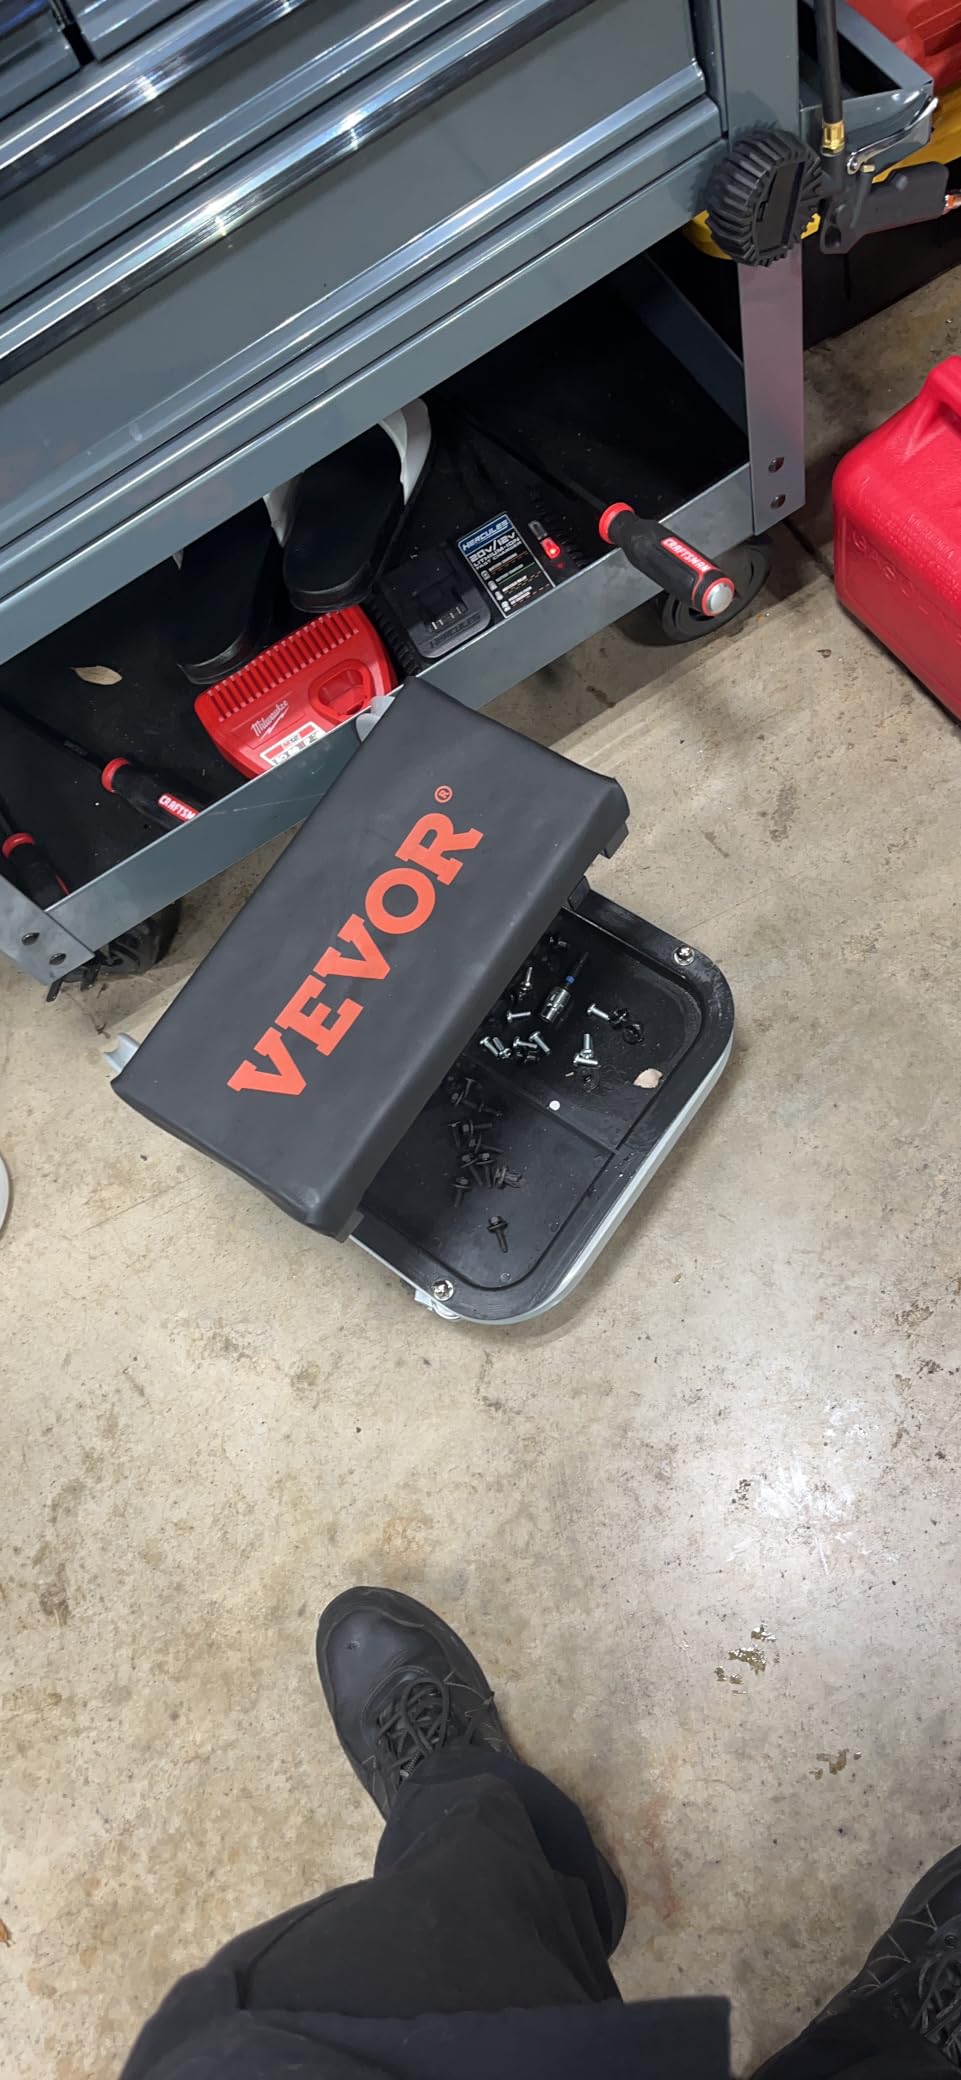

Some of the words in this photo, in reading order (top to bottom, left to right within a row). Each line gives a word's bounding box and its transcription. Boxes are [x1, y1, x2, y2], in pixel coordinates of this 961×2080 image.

[461, 519, 508, 551] HERCULES
[472, 536, 521, 567] LITHIUM-ION
[664, 538, 712, 573] CRAFTSMAN
[251, 701, 290, 737] Milwaukee
[158, 795, 196, 821] CRAFTSM
